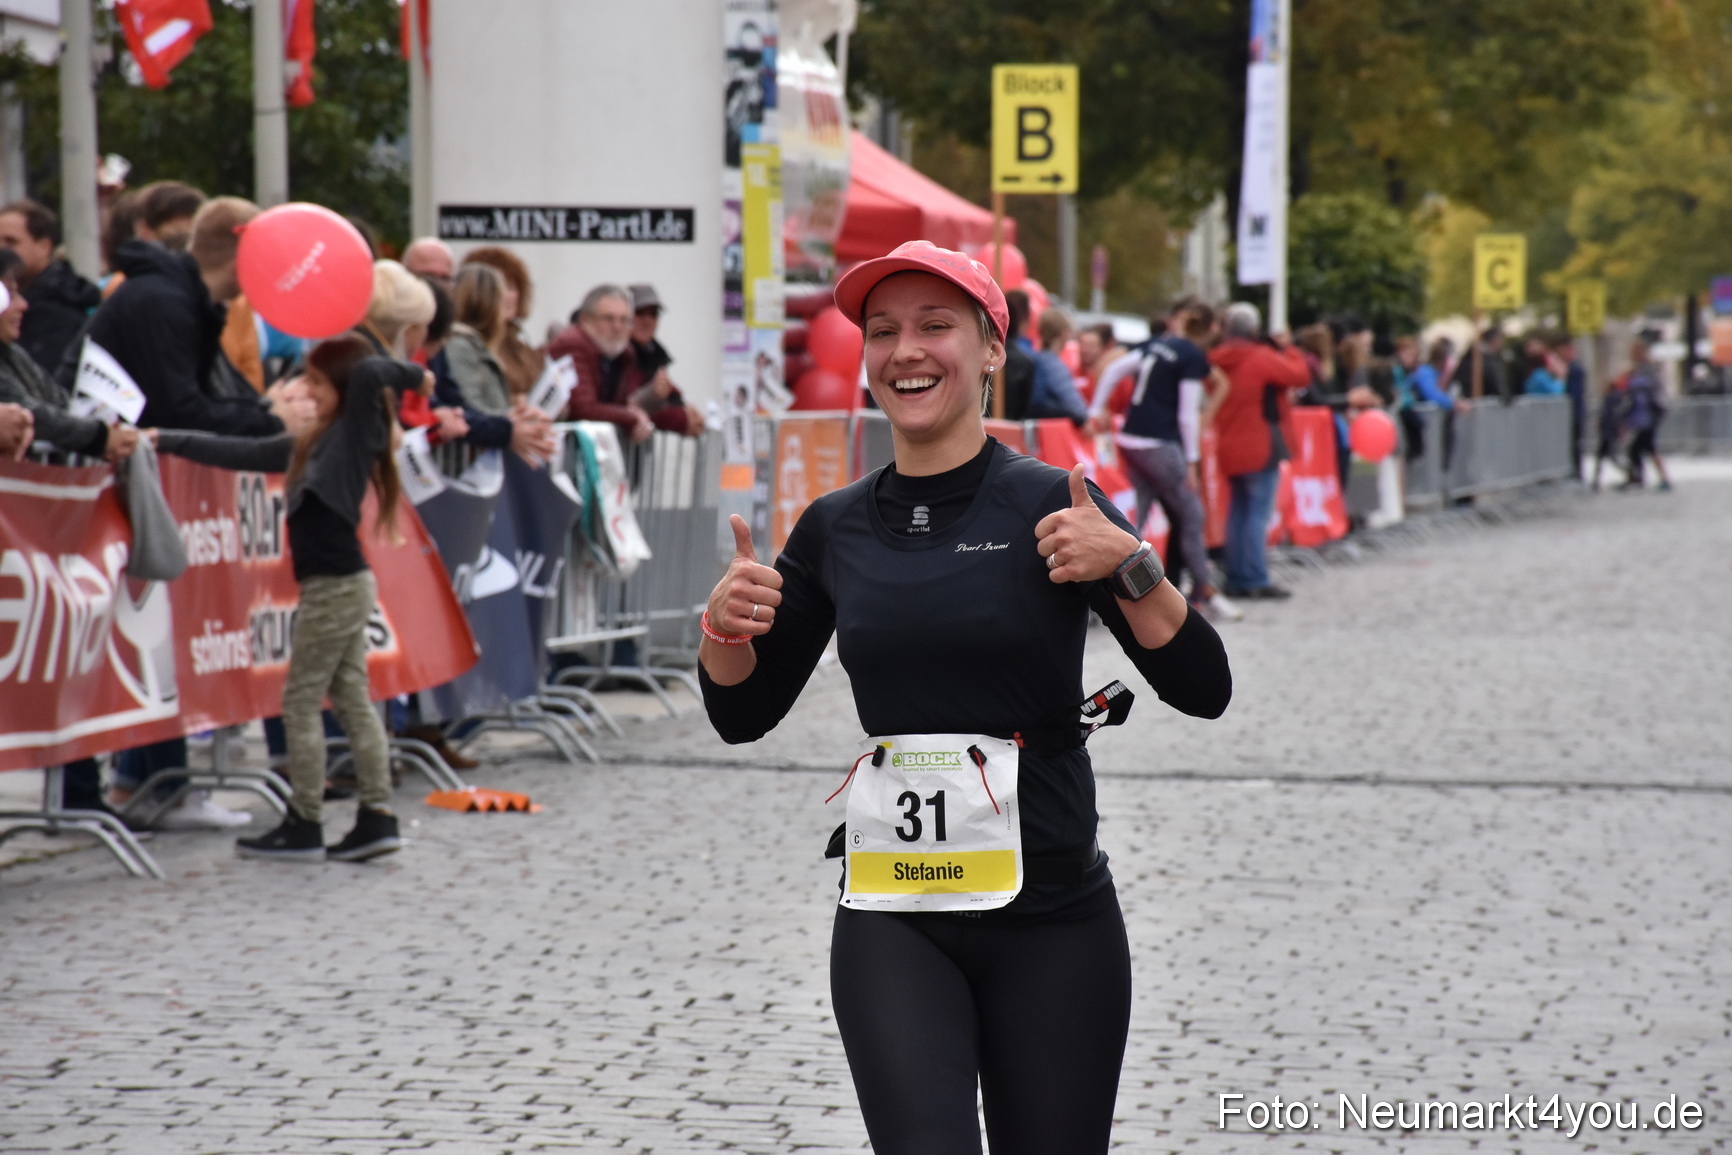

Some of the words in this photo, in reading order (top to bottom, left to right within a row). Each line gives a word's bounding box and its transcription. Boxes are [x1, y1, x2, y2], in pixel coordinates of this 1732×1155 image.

[1004, 73, 1065, 94] Block
[1017, 106, 1053, 161] B
[1488, 257, 1511, 291] C
[955, 543, 982, 552] Pearl
[982, 541, 1010, 551] Izumi
[903, 752, 961, 766] BOCK
[895, 790, 947, 842] 31
[854, 834, 860, 844] C
[894, 862, 964, 880] Stefanie
